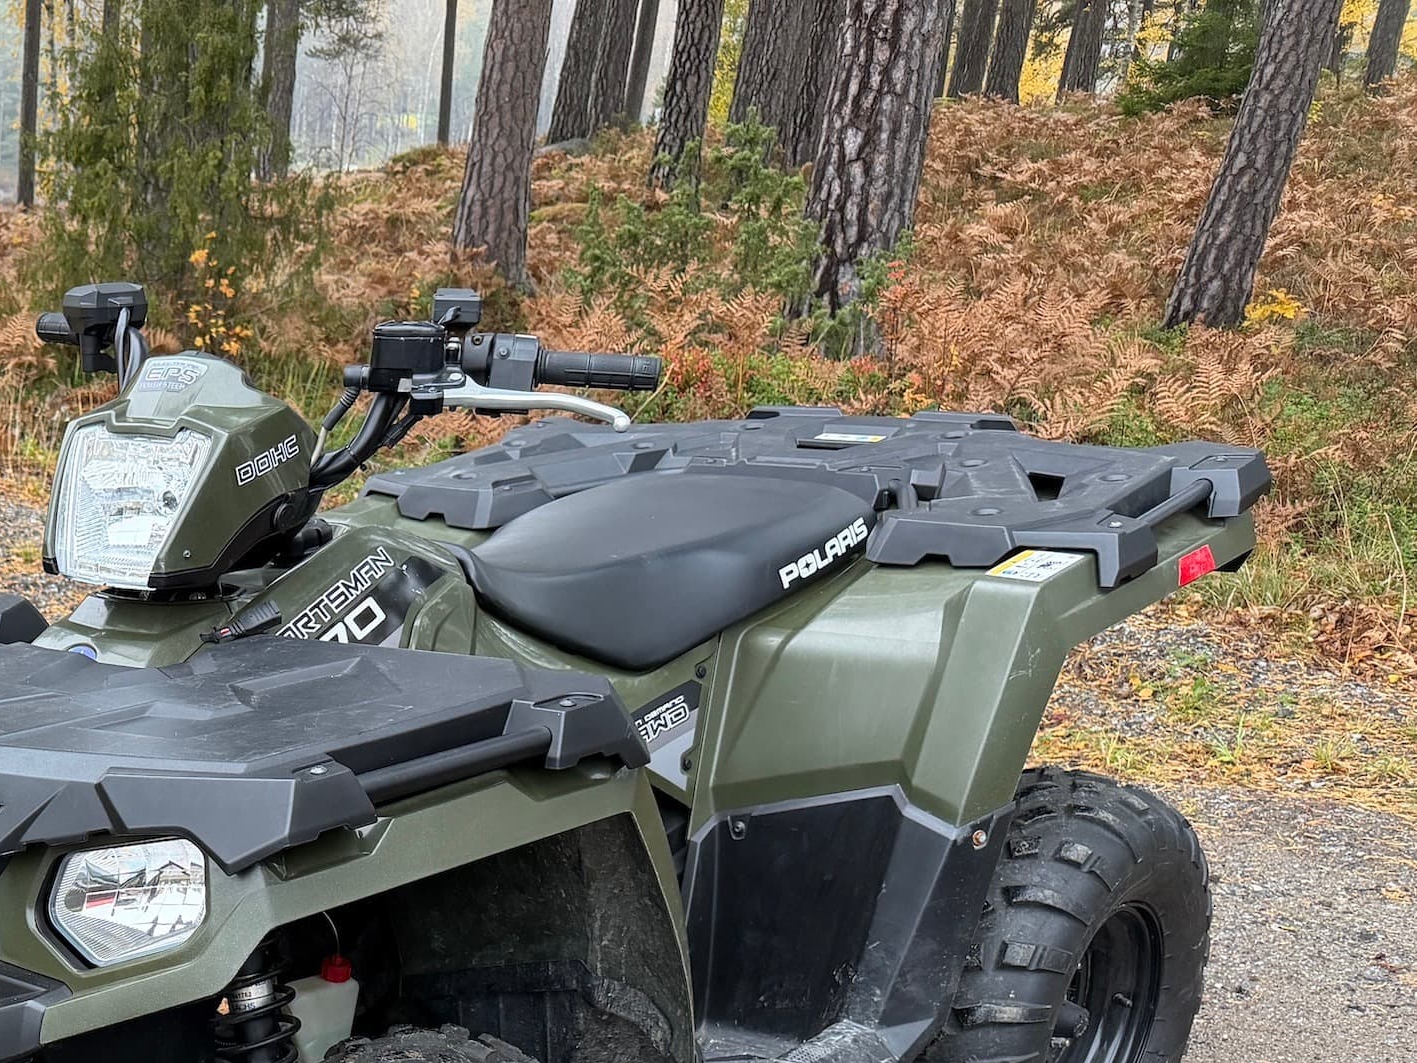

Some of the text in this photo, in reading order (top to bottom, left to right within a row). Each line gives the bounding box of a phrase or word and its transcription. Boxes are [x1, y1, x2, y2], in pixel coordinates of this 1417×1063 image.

[145, 366, 199, 385] EPS
[234, 433, 300, 487] DOHC
[778, 516, 869, 590] POLARIS
